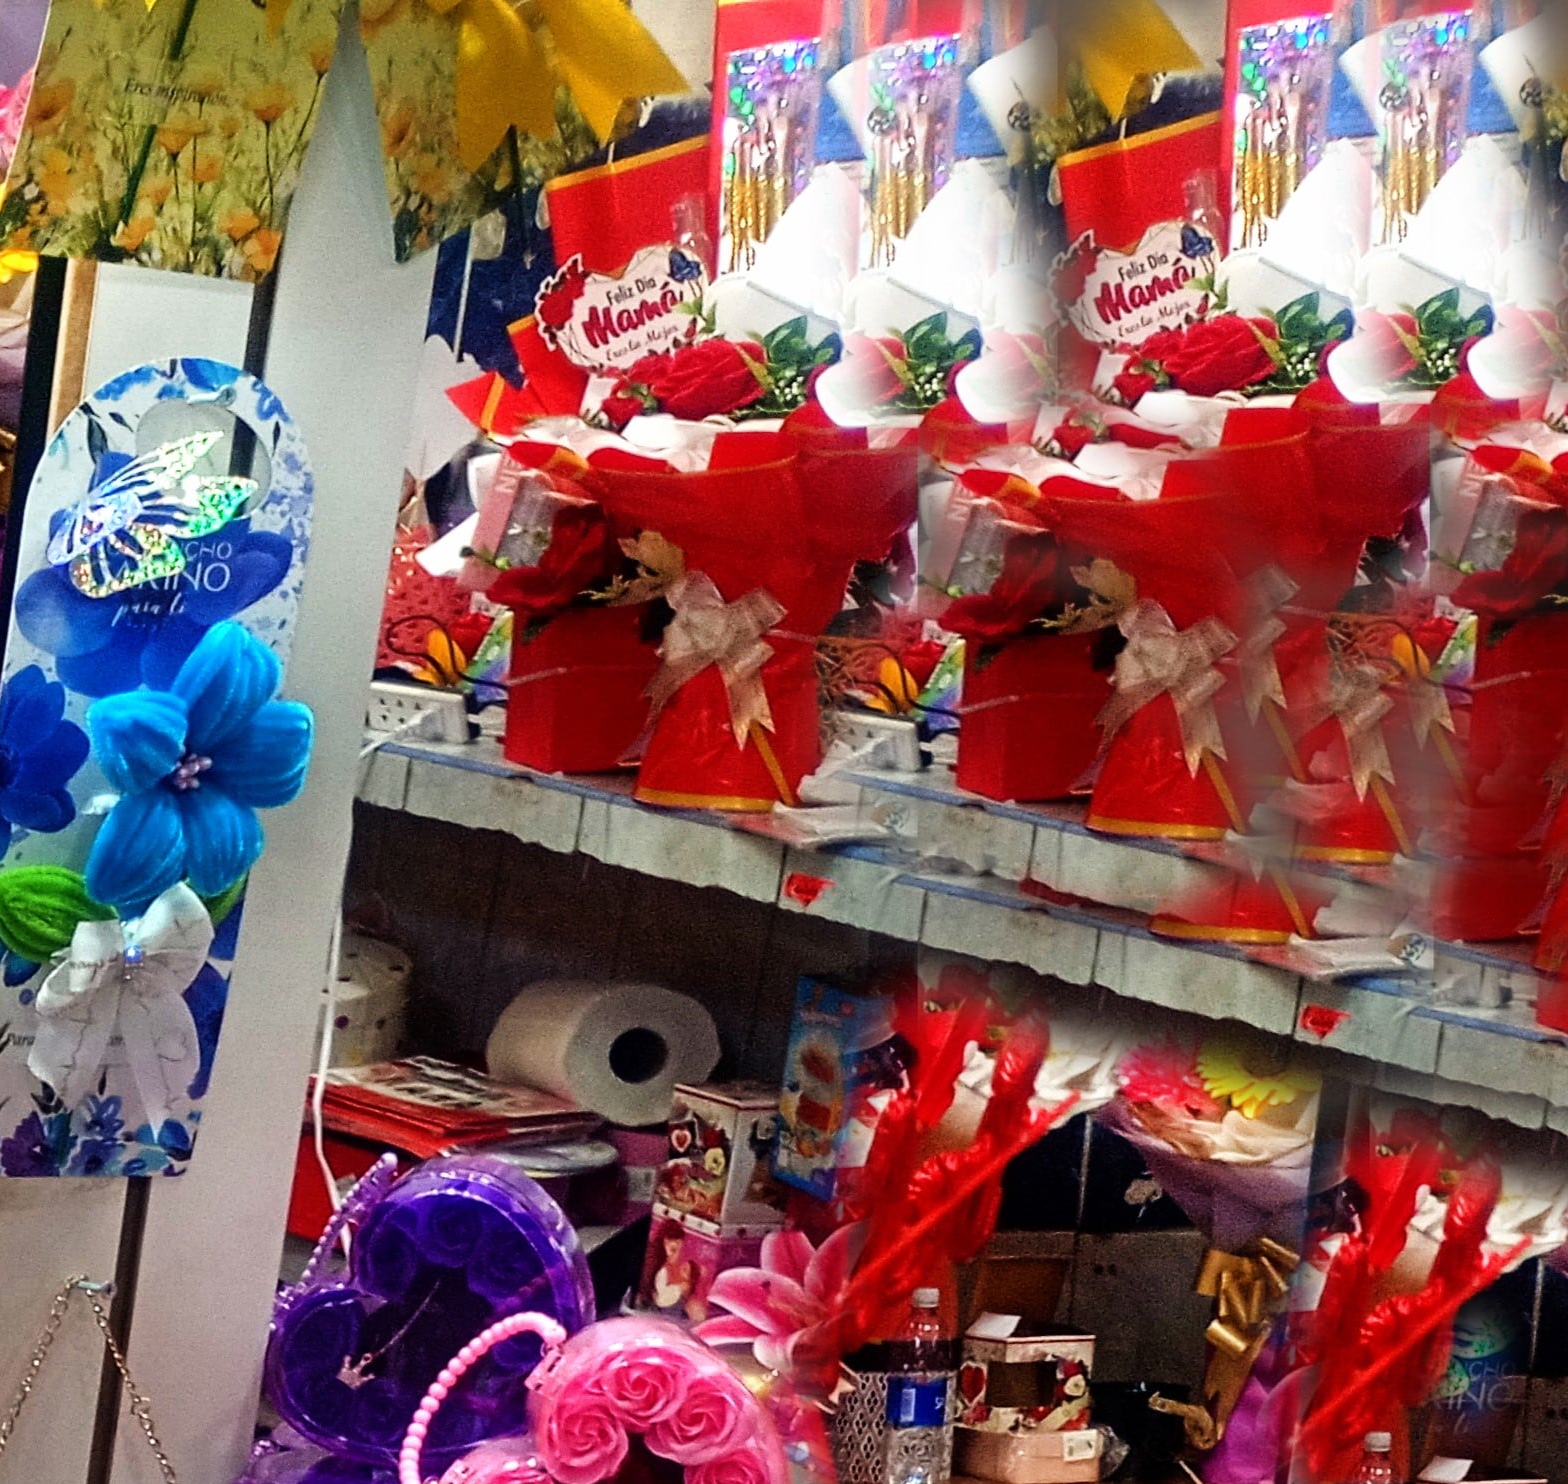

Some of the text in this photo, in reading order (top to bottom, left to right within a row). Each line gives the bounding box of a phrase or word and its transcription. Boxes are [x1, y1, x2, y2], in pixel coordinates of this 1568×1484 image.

[1118, 260, 1147, 282] Feliz
[606, 284, 634, 306] Feliz
[1093, 257, 1196, 325] Mamá
[581, 281, 684, 349] Mamá
[179, 541, 232, 561] CHO
